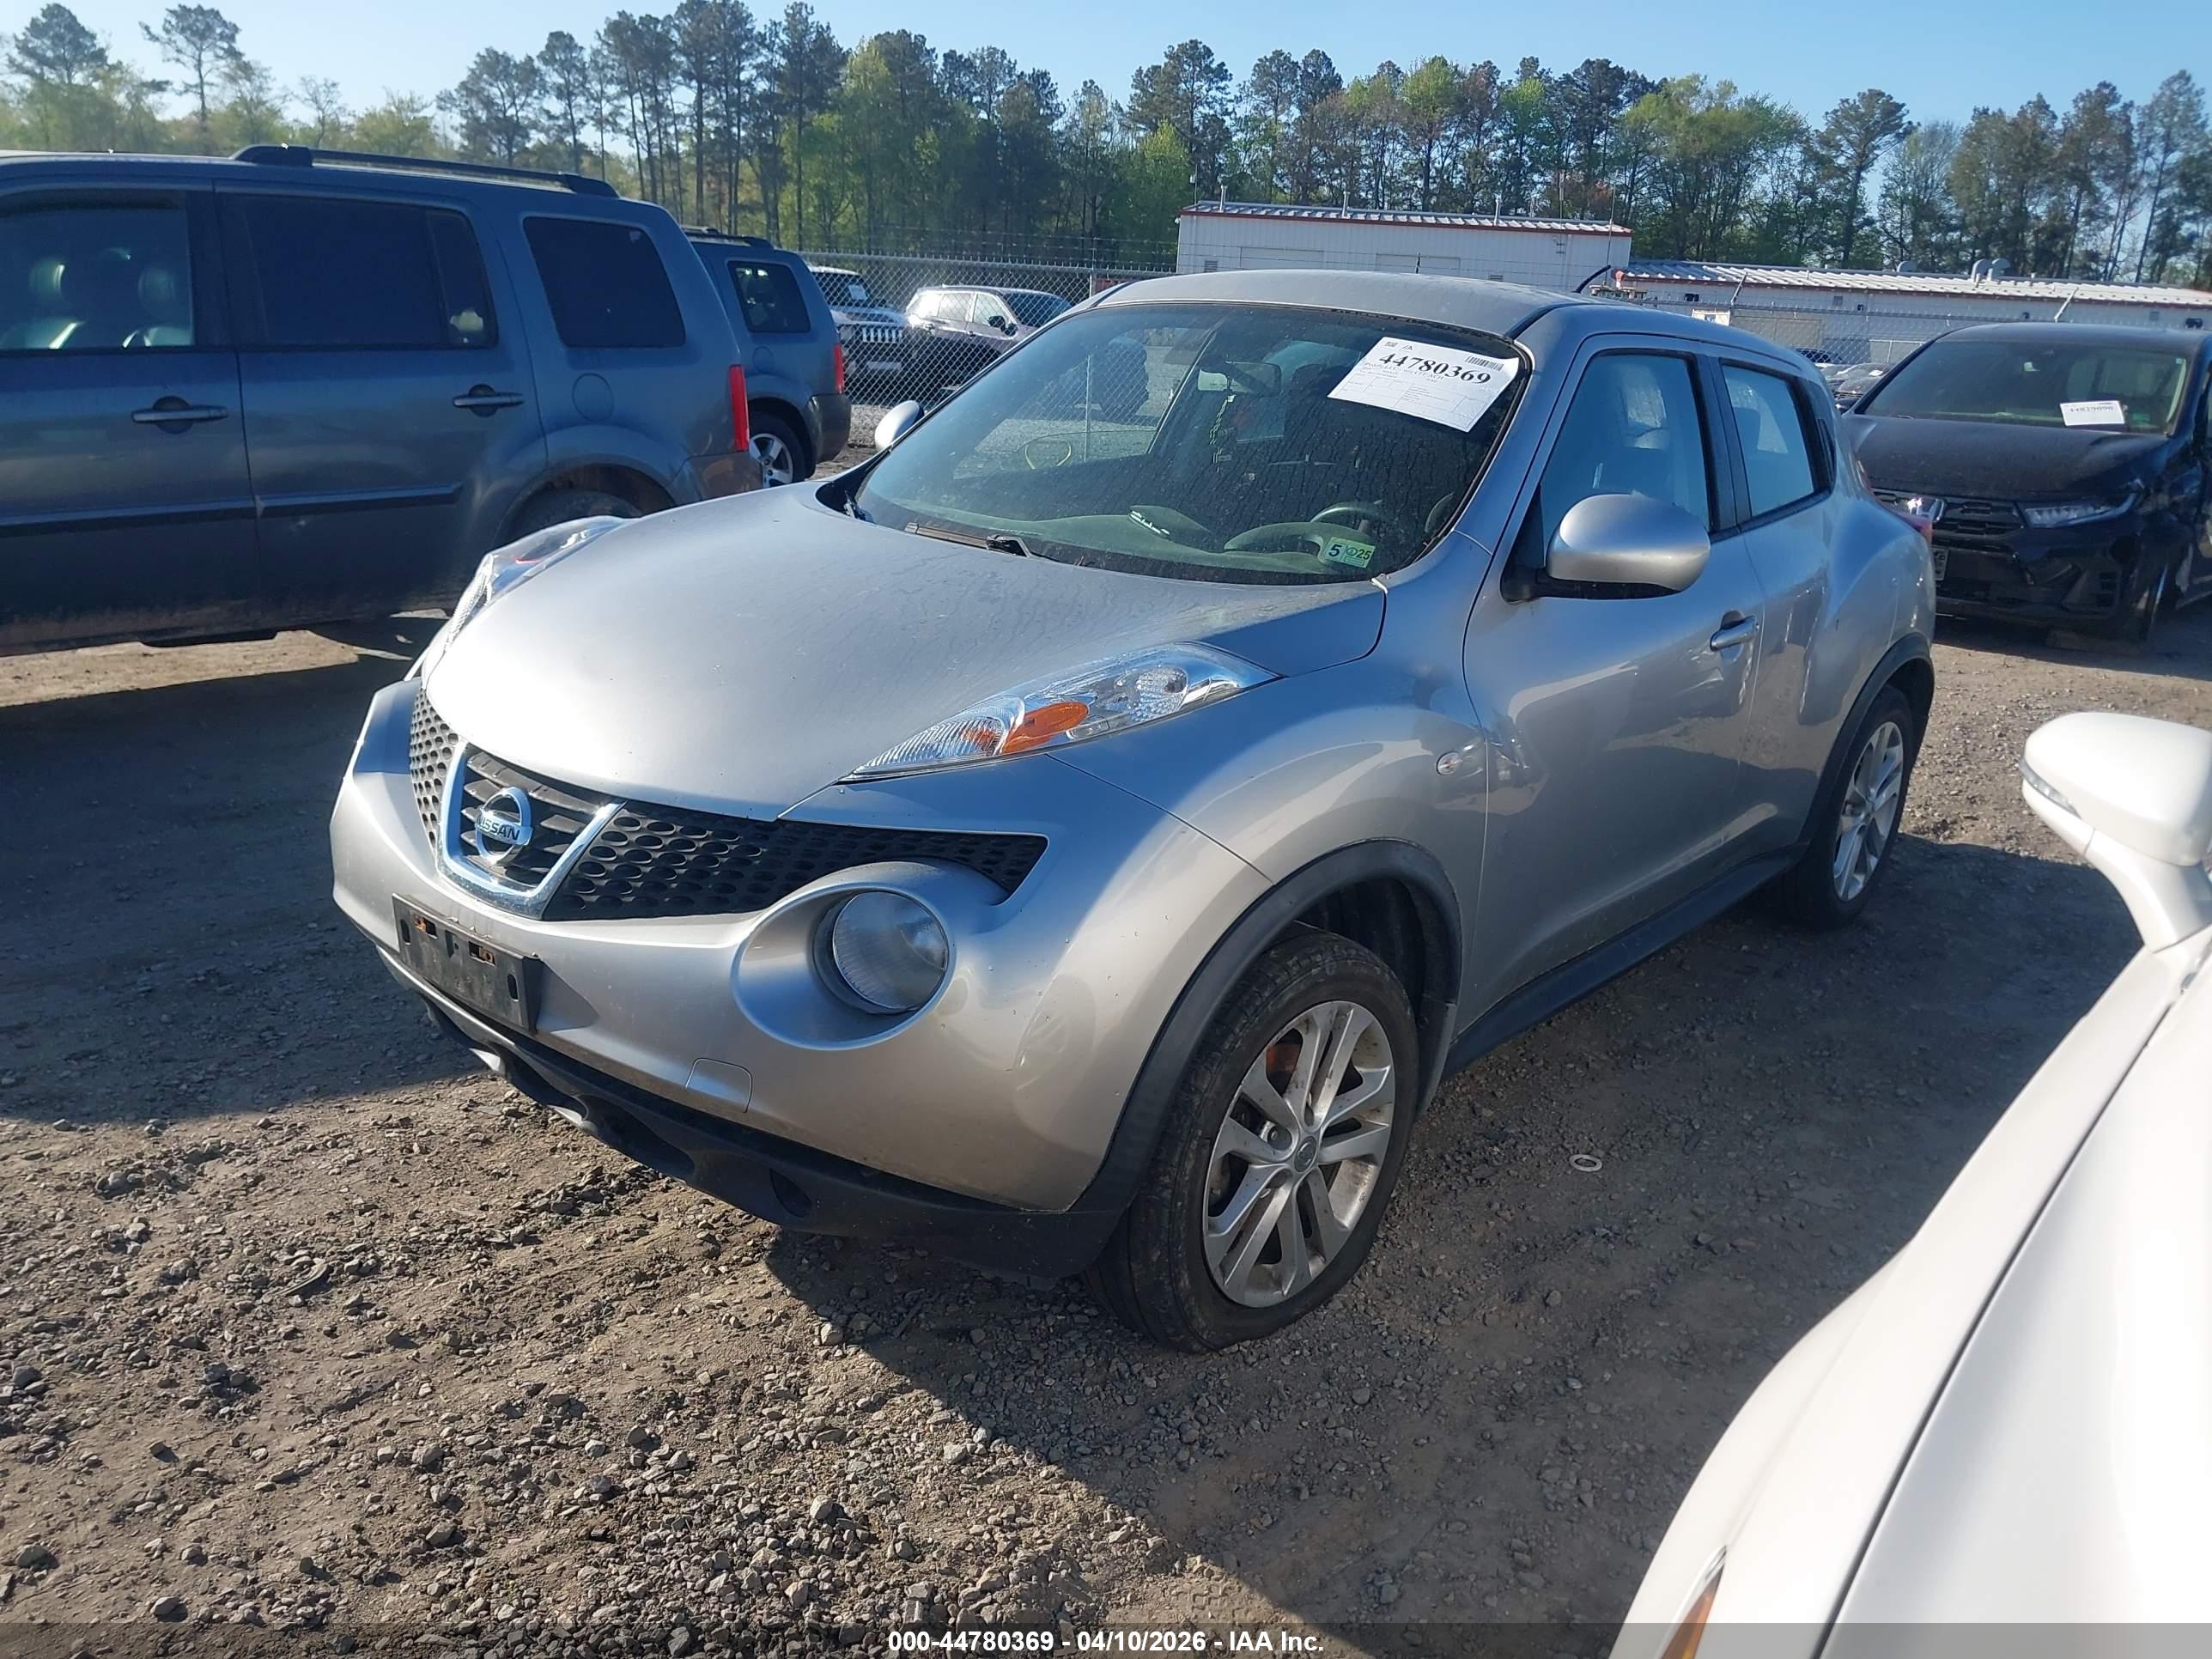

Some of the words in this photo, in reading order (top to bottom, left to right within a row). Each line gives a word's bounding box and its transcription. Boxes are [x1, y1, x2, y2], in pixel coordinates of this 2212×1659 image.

[1379, 353, 1492, 385] 44780369
[1328, 544, 1342, 556] 5
[1356, 549, 1371, 560] 25
[477, 816, 520, 841] NISSAN
